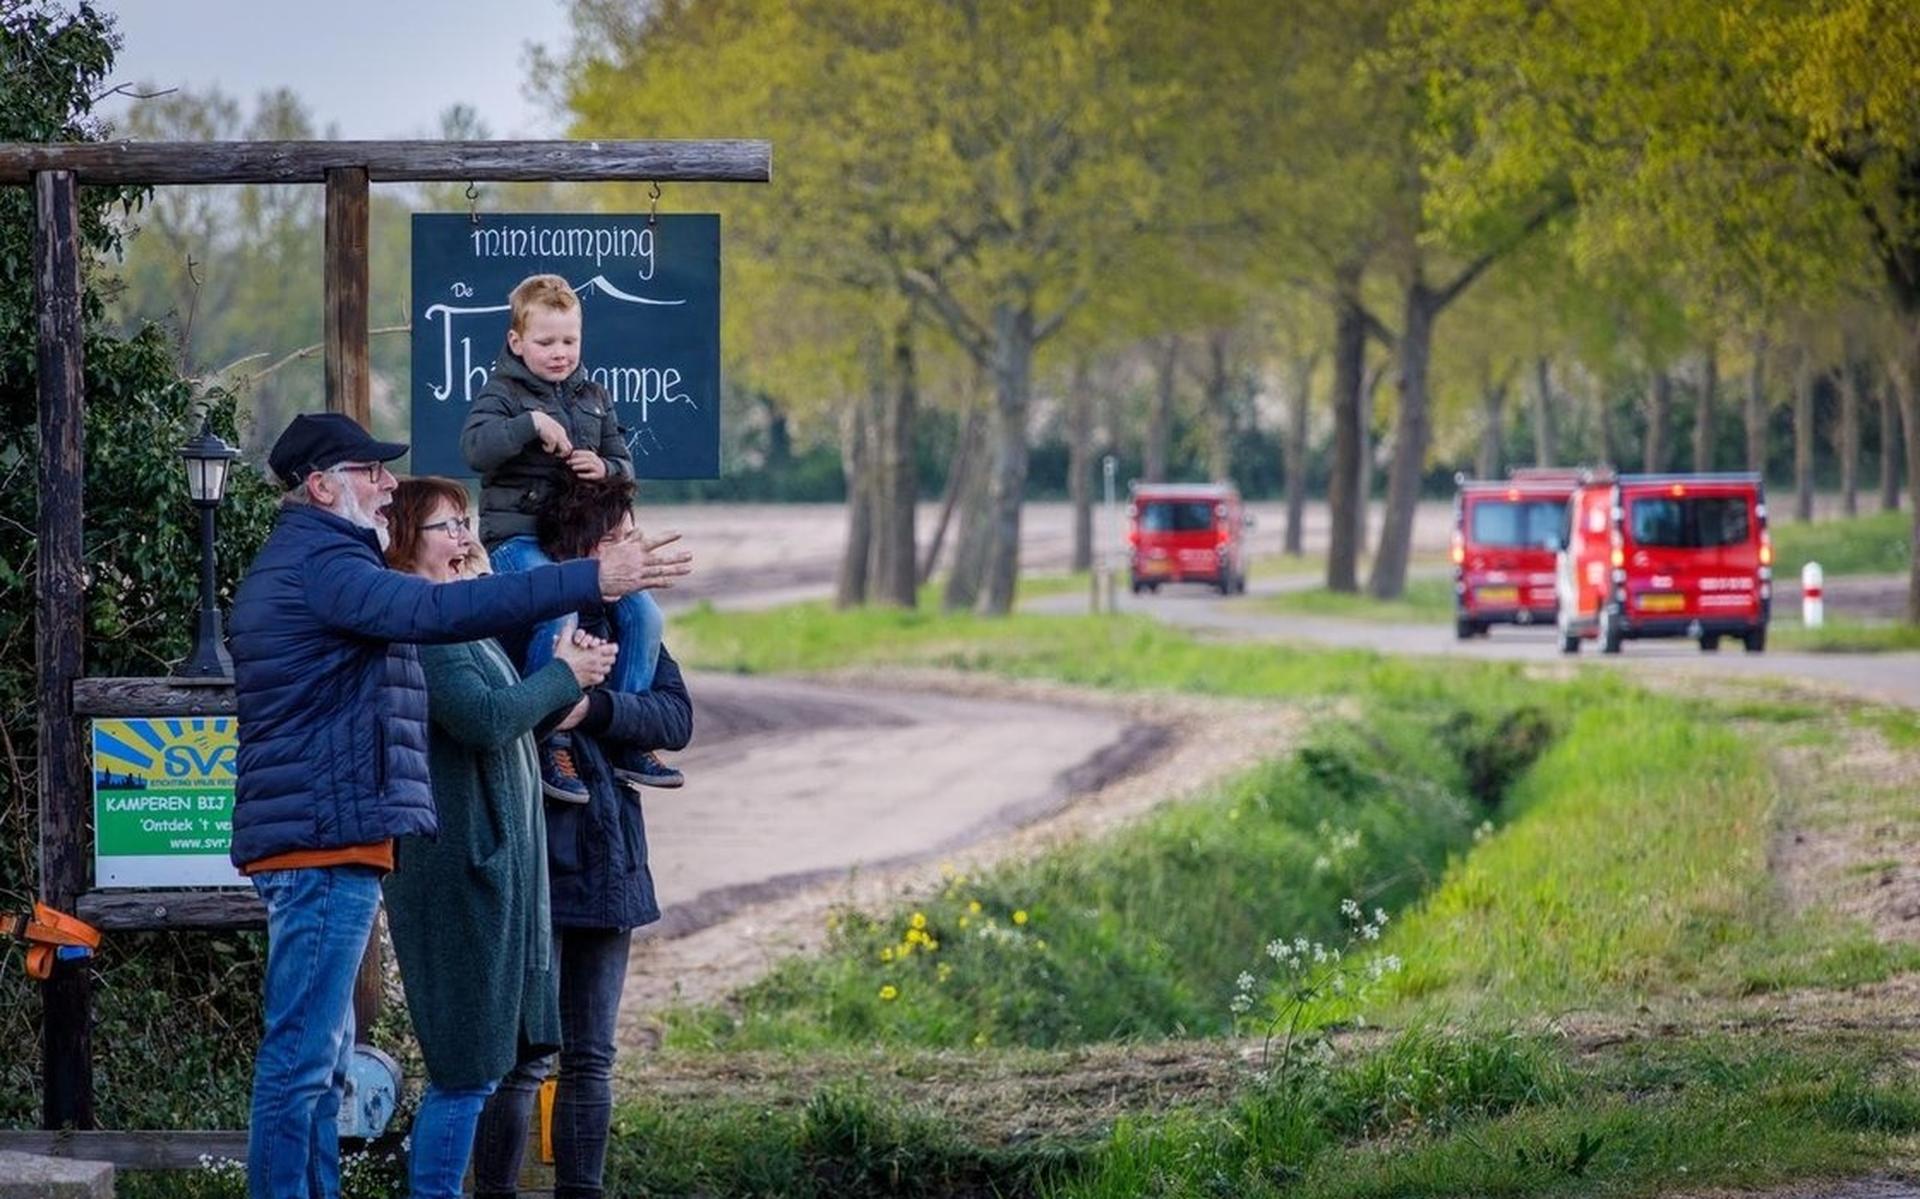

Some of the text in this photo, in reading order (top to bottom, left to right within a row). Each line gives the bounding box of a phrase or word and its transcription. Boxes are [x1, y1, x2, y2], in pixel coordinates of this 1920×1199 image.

[471, 225, 655, 281] minicamping
[450, 282, 474, 298] De
[105, 797, 191, 812] KAMPEREN
[198, 796, 226, 810] BIJ
[170, 838, 232, 849] www.svr.
